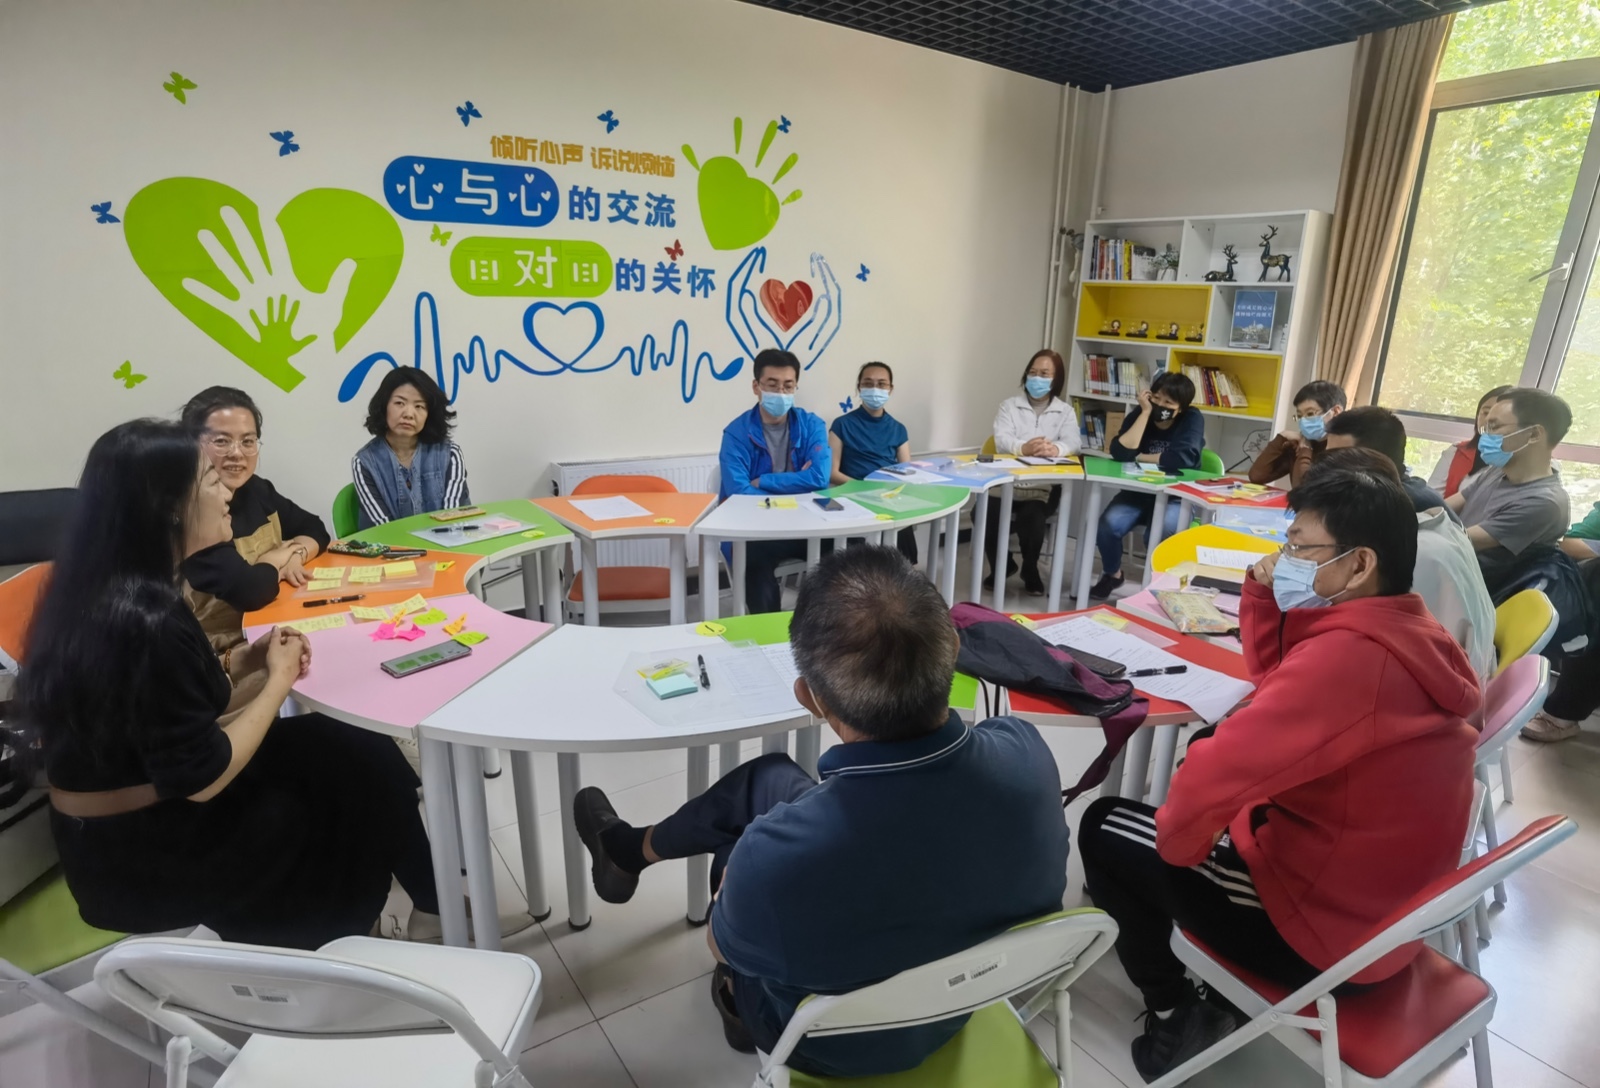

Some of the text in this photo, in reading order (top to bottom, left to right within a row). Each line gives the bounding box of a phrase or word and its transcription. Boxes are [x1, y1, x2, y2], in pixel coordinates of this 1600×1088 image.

[490, 135, 675, 178] 倾听心声 诉说烦恼
[395, 163, 676, 228] 心与心的交流
